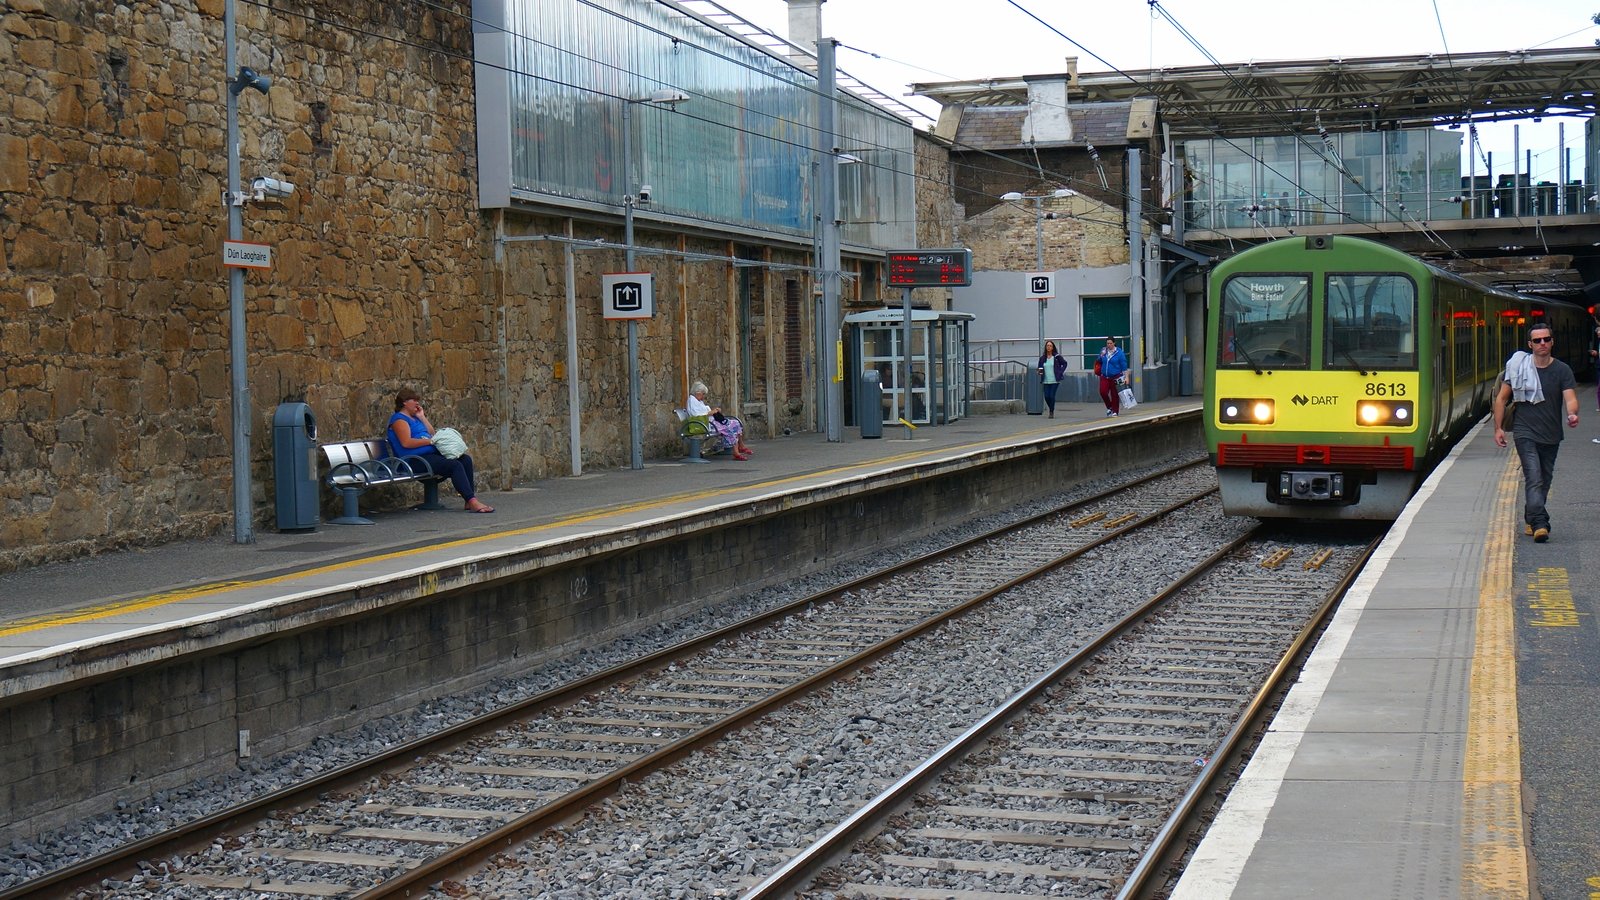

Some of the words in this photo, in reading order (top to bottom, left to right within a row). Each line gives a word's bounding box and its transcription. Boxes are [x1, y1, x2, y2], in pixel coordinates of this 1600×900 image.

[228, 248, 240, 258] Dún
[240, 250, 267, 262] Laoghaire
[1250, 283, 1284, 292] Howth
[1365, 382, 1406, 396] 8613
[1311, 396, 1338, 406] DART
